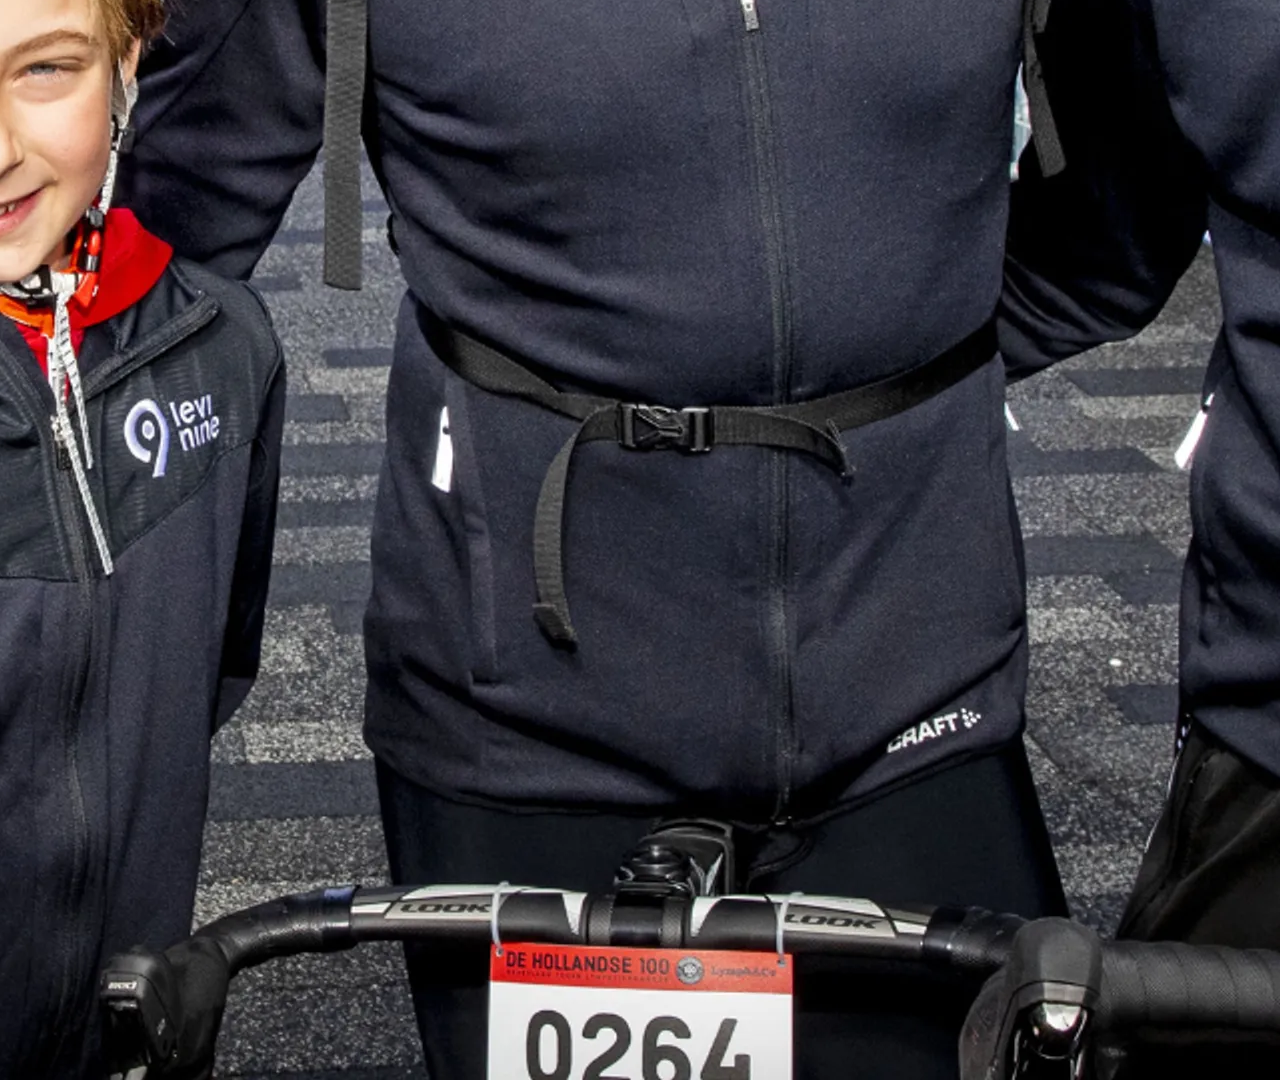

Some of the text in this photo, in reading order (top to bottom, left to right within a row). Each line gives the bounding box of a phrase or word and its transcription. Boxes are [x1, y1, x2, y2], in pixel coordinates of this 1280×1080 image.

[169, 394, 212, 427] levi
[179, 416, 219, 452] nine
[887, 712, 958, 753] CRAFT
[401, 903, 492, 913] LOOK
[784, 914, 882, 929] LOOK
[506, 951, 669, 974] DE HOLLANDSE 100
[526, 1009, 751, 1080] 0264
